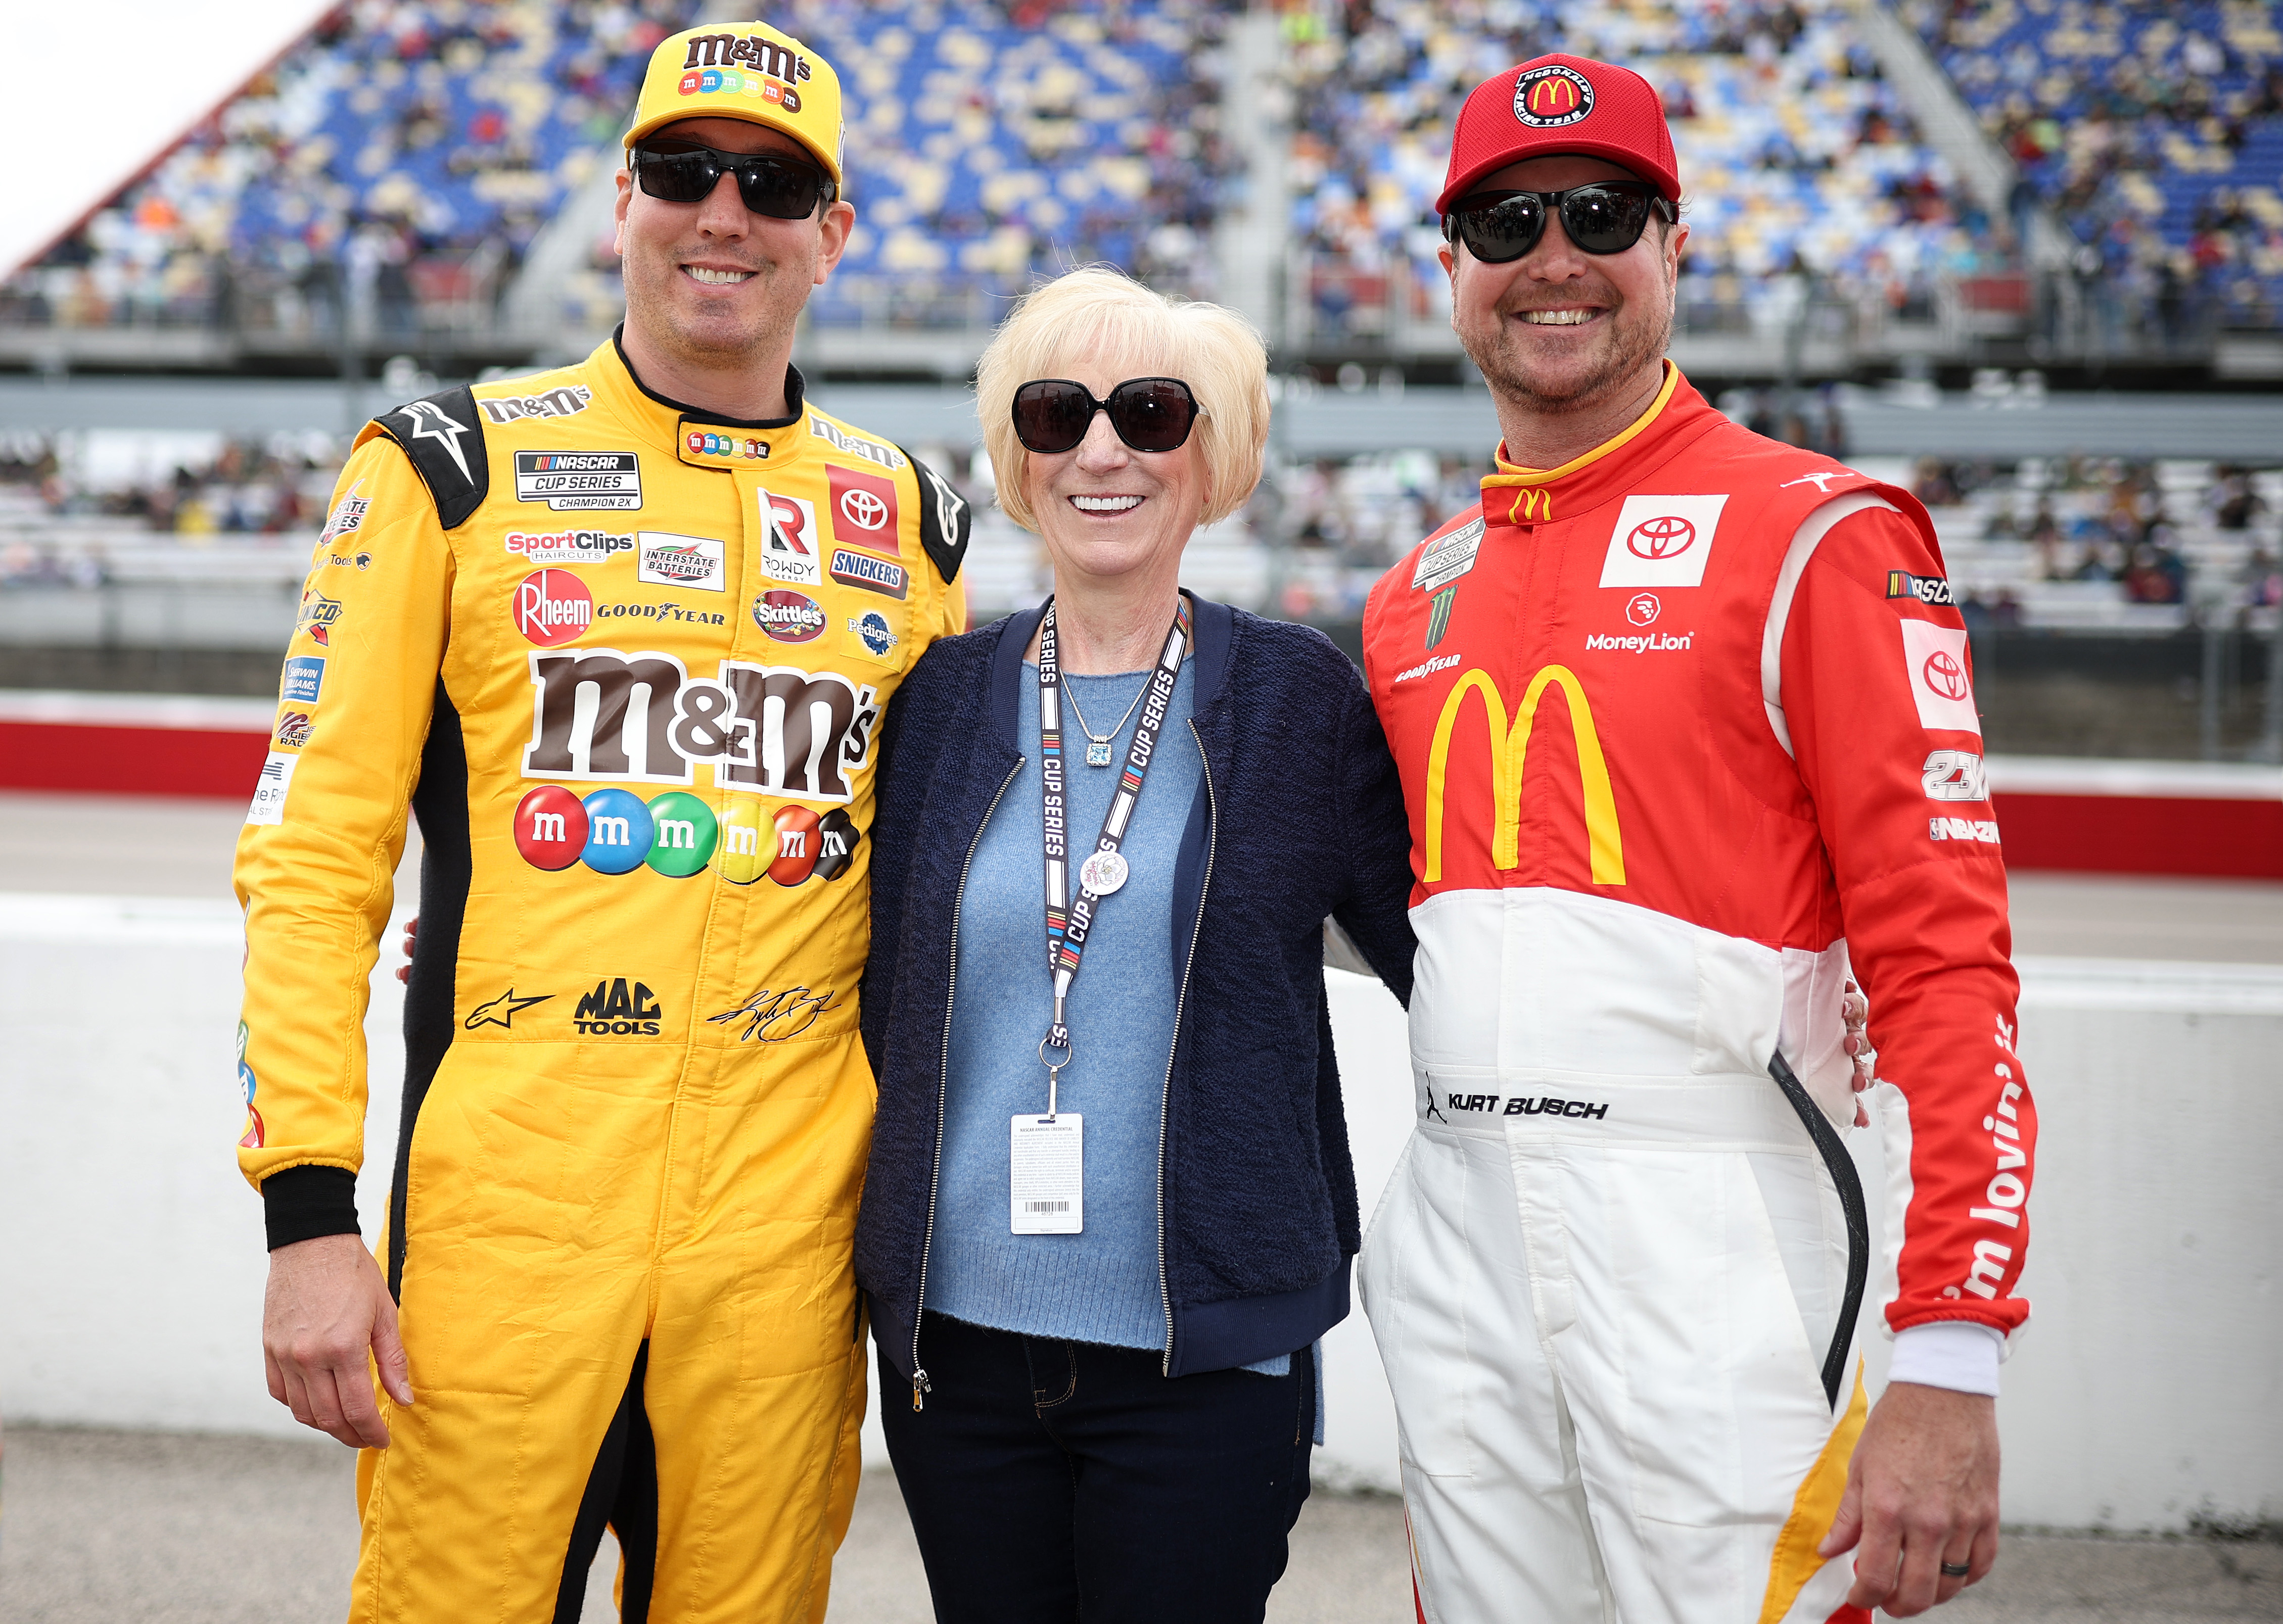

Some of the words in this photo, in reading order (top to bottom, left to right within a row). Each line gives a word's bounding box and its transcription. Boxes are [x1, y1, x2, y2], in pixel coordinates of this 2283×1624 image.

[1516, 93, 1541, 124] RACING
[1545, 110, 1582, 125] TEAM
[554, 456, 619, 470] NASCAR
[535, 477, 566, 490] CUP
[568, 476, 622, 489] SERIES
[558, 499, 614, 508] CHAMPION
[618, 498, 631, 507] 2X
[1441, 520, 1481, 550] NASCAR
[331, 554, 352, 565] Tools
[535, 551, 601, 559] HAIRCUTS
[645, 550, 715, 567] INTERSTATE
[762, 554, 815, 577] ROWDY
[1423, 555, 1442, 574] CUP
[1440, 540, 1473, 566] SERIES
[647, 561, 711, 577] BATTERIES
[771, 572, 804, 582] ENERGY
[834, 553, 900, 586] SNICKERS
[1433, 563, 1466, 586] CHAMPION
[521, 569, 590, 637] Rheem
[759, 603, 822, 626] Skittles
[847, 617, 898, 645] Pedigree
[1585, 633, 1691, 654] MoneyLion
[1040, 629, 1057, 683] SERIES
[1141, 669, 1175, 732] SERIES
[1130, 729, 1154, 768] CUP
[1043, 758, 1062, 792] CUP
[1044, 795, 1064, 856] SERIES
[1067, 900, 1092, 943] CUP
[574, 978, 661, 1020] MAC
[573, 1020, 660, 1035] TOOLS
[1448, 1093, 1500, 1113] KURT
[1503, 1097, 1609, 1120] BUSCH
